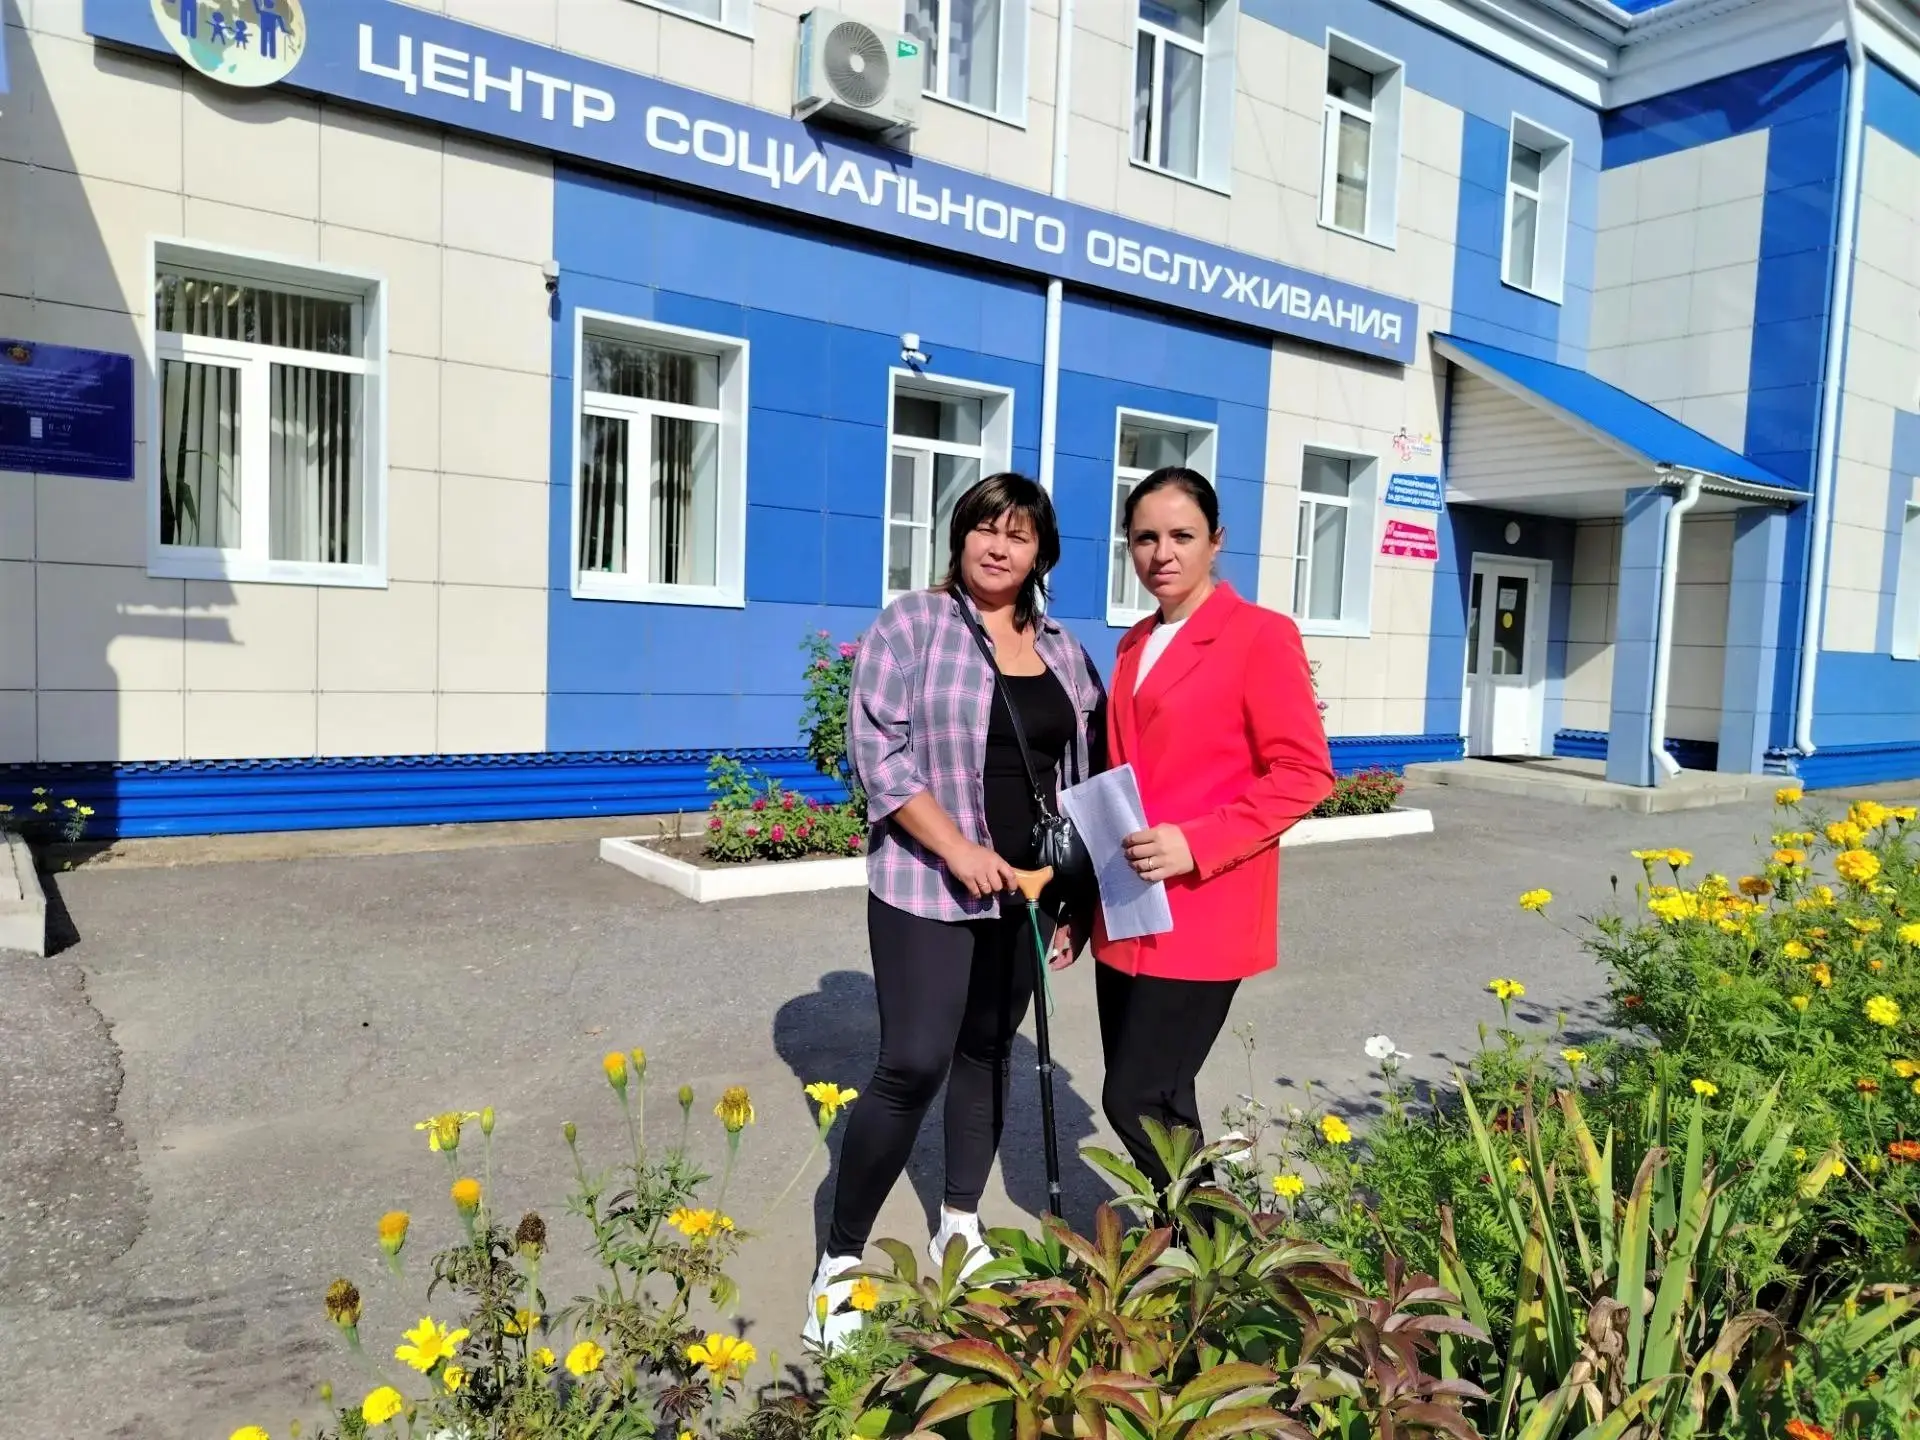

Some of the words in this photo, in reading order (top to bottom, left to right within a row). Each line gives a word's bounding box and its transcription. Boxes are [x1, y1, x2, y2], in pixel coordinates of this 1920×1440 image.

[359, 23, 616, 128] ЦЕНТР
[645, 105, 1066, 255] СОЦИАЛЬНОГО
[1086, 229, 1402, 344] ОБСЛУЖИВАНИЯ
